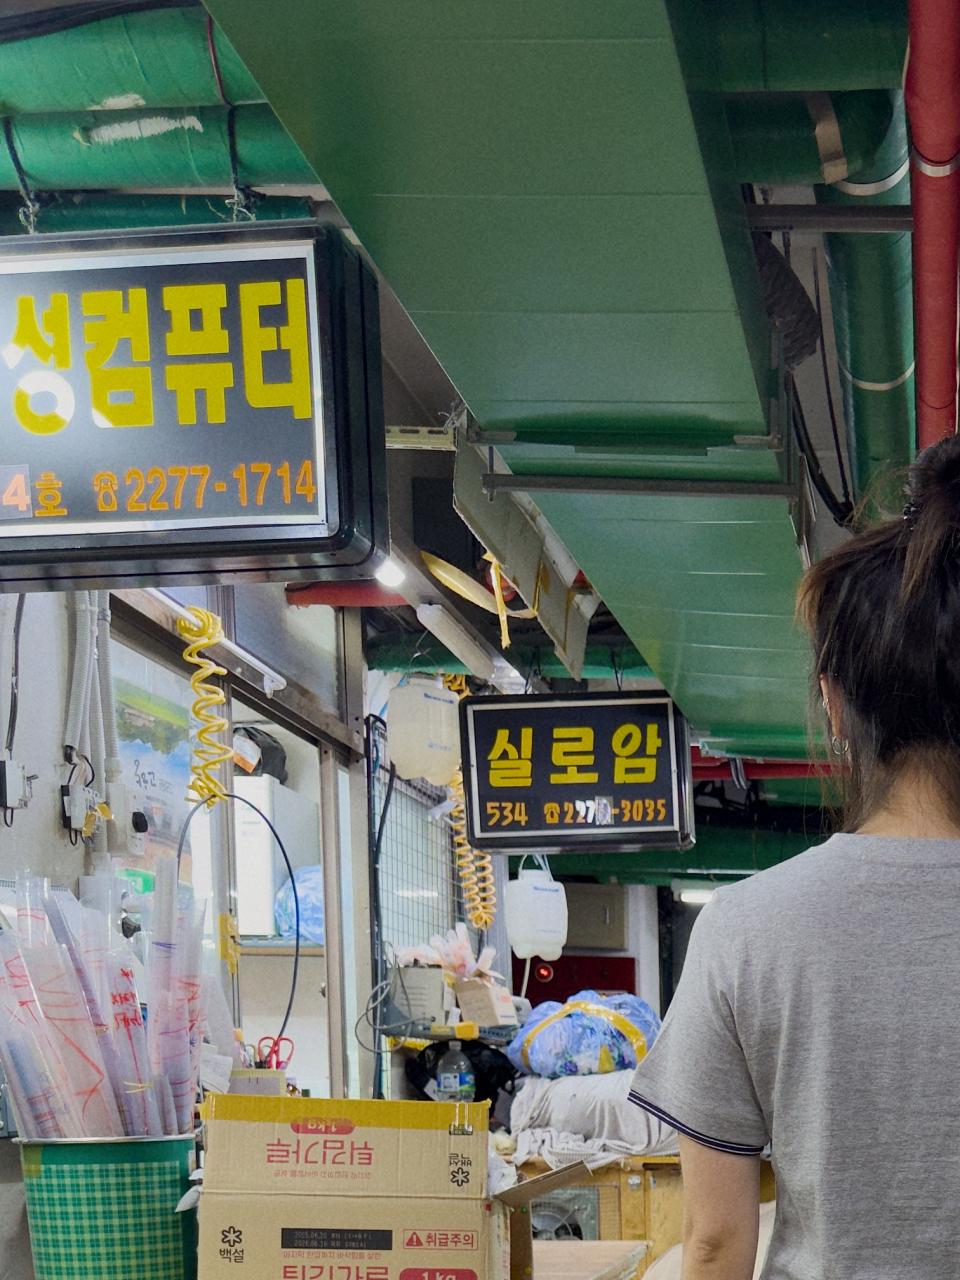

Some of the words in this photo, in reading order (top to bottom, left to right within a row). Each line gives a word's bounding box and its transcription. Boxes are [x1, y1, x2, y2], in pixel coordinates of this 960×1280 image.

[3, 278, 312, 434] 성컴퓨터
[126, 460, 316, 512] 2277-1714
[487, 723, 663, 788] 실로암
[486, 802, 528, 826] 534
[564, 798, 666, 825] 227-3035
[266, 1138, 374, 1166] 튀김가루
[425, 1233, 475, 1248] 취급주의
[219, 1248, 245, 1263] 백설
